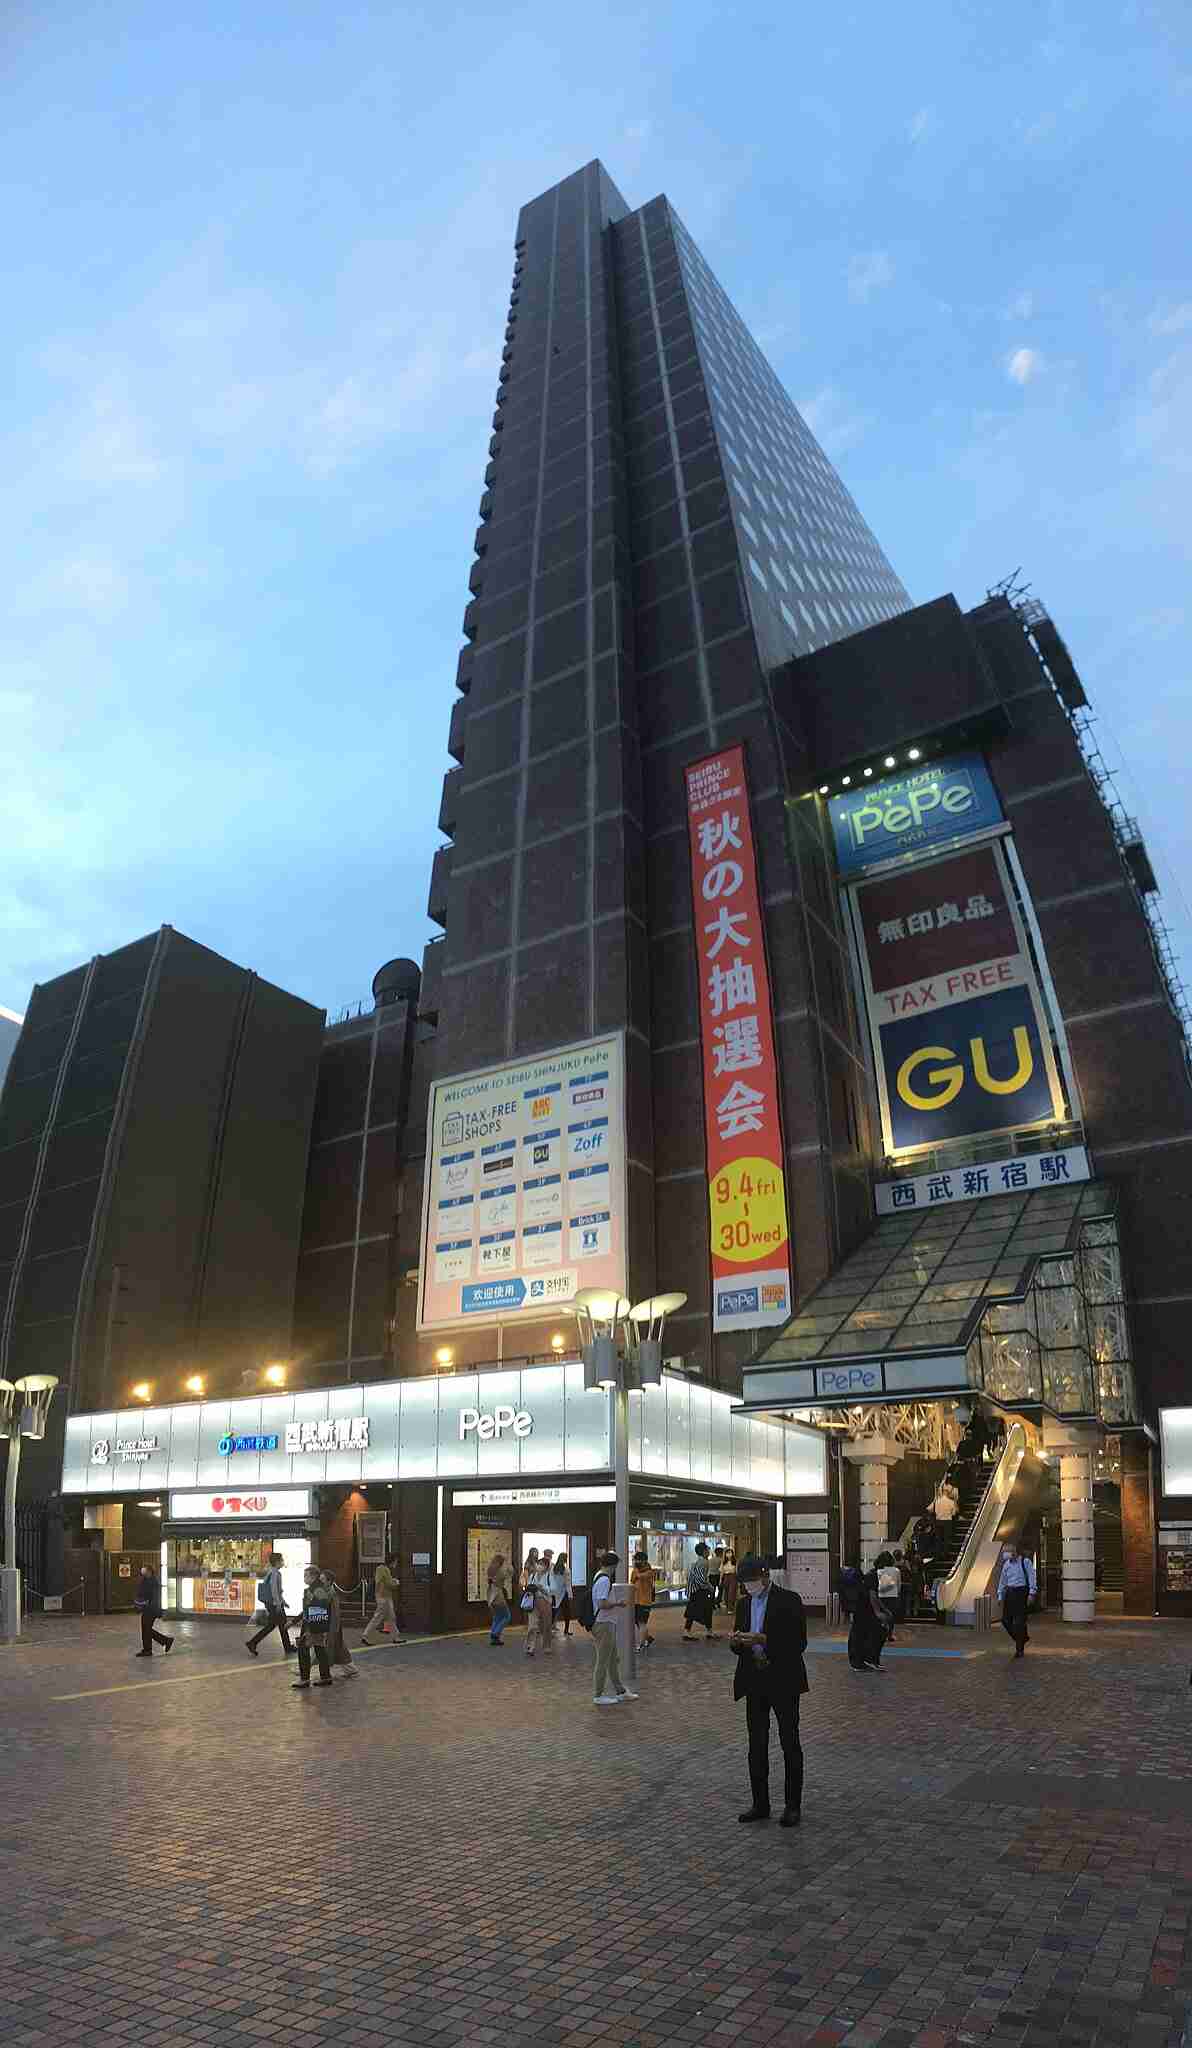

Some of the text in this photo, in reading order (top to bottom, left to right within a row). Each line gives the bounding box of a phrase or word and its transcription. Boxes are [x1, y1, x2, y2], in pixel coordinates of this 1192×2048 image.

[689, 768, 730, 793] PRINCE
[852, 785, 973, 845] PePe
[878, 894, 994, 944] 無印良品
[698, 810, 765, 1141] 秋の大抽選会
[885, 961, 1015, 1015] TAX FREE
[444, 1078, 491, 1102] WELCOME
[507, 1070, 530, 1088] SEIBU
[533, 1059, 581, 1079] SHINJUKU
[897, 1025, 1034, 1111] GU
[465, 1100, 517, 1125] TAX-FREE
[465, 1120, 502, 1141] SHOPS
[574, 1133, 603, 1153] Zoff
[716, 1171, 776, 1204] 9.4 fri
[891, 1153, 1070, 1208] 西武新宿駅
[720, 1220, 780, 1250] 30 wed
[822, 1368, 874, 1391] PePe
[459, 1405, 534, 1441] PePe
[117, 1436, 157, 1450] Prince Hotel
